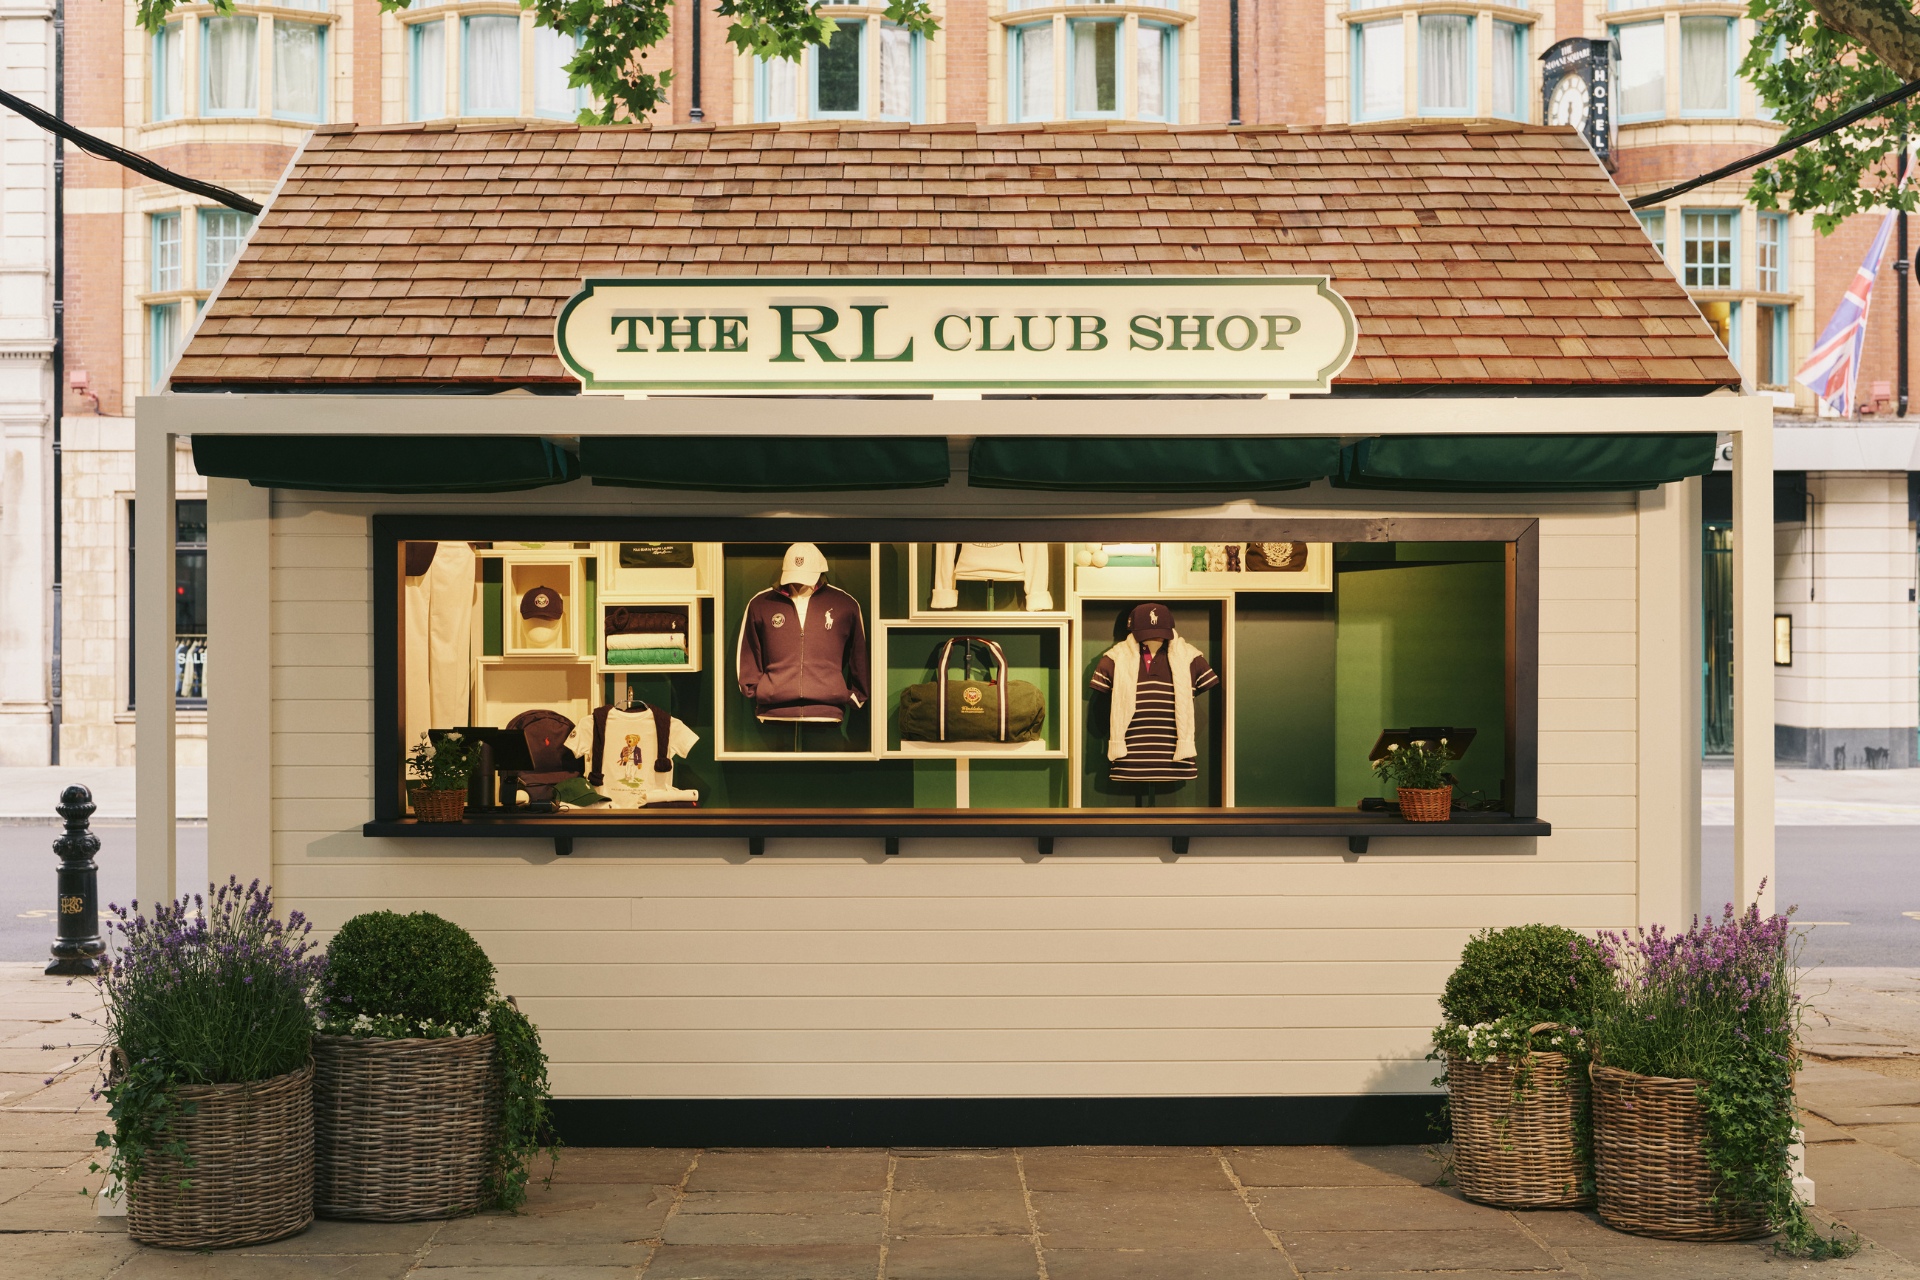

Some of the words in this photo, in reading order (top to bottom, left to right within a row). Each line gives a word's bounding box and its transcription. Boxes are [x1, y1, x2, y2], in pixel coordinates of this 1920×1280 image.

[1594, 69, 1606, 148] HOTEL
[611, 316, 749, 353] THE
[769, 305, 914, 363] RL
[934, 314, 1109, 352] CLUB
[1129, 314, 1302, 352] SHOP
[177, 652, 207, 665] SALE
